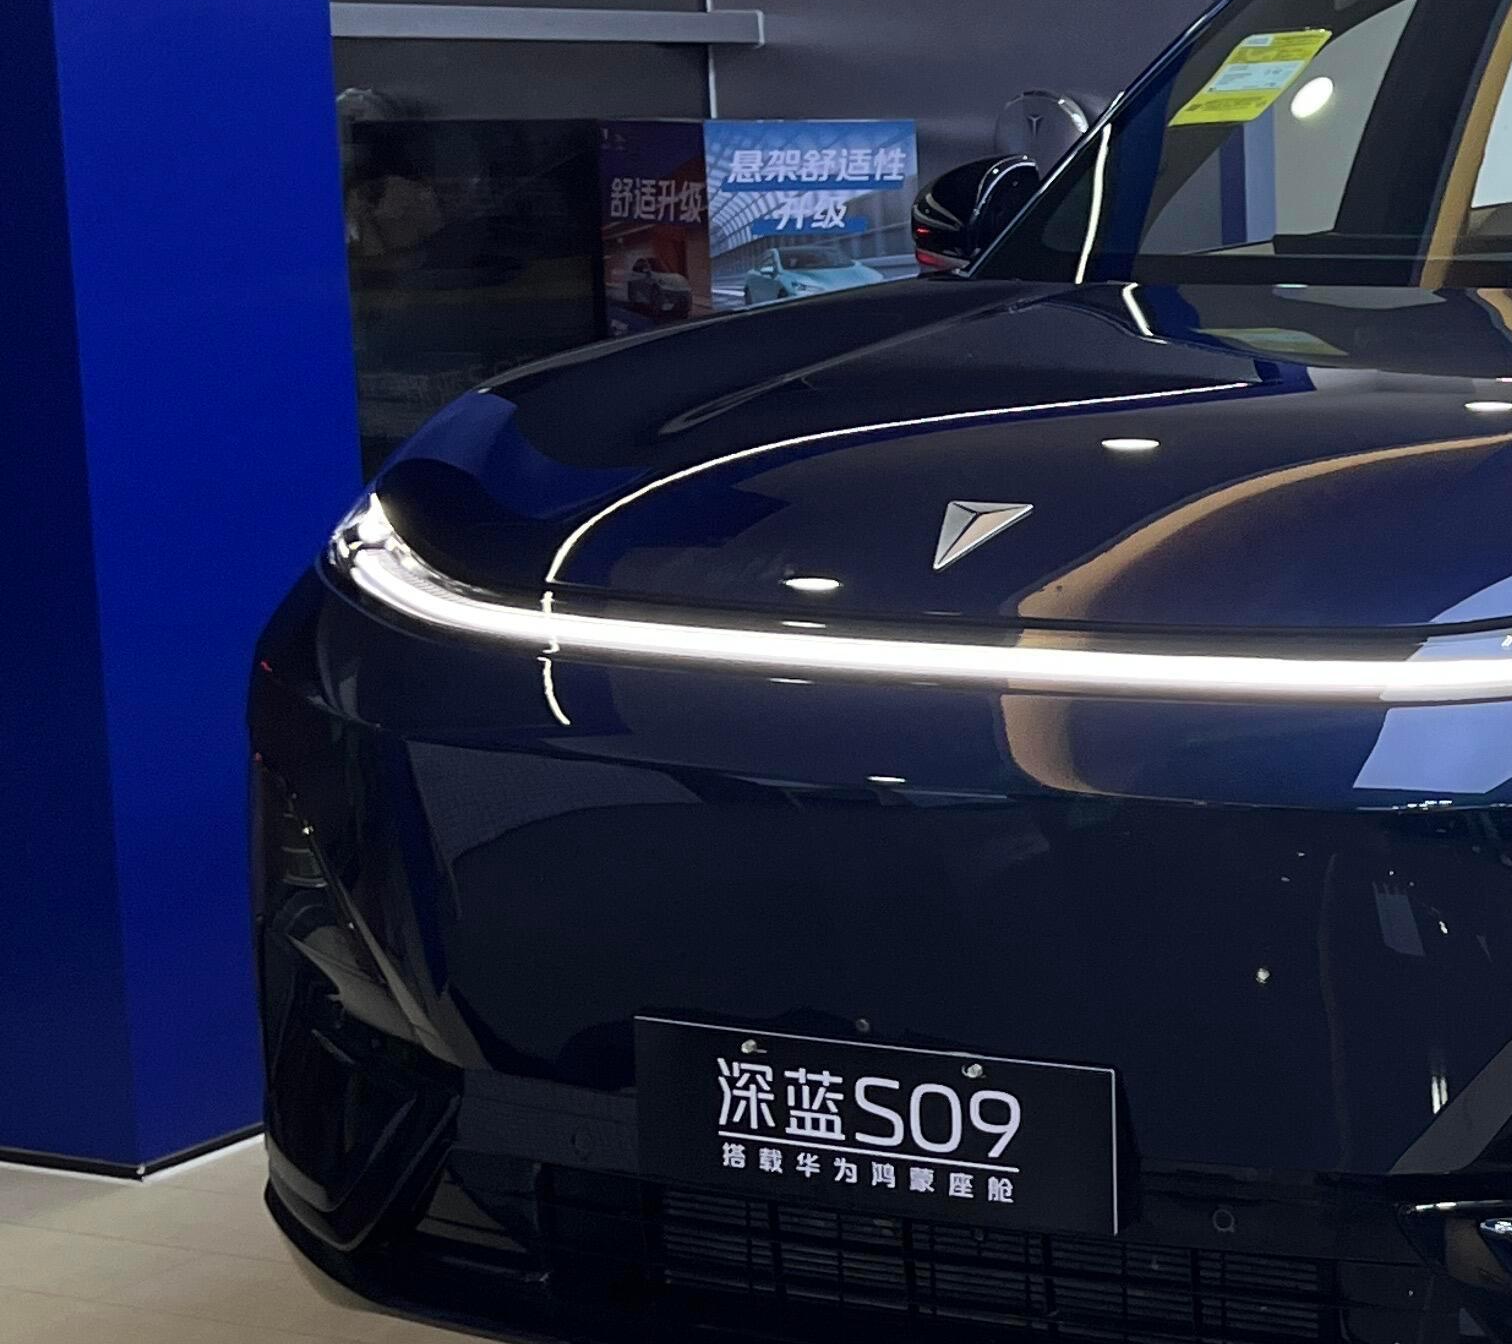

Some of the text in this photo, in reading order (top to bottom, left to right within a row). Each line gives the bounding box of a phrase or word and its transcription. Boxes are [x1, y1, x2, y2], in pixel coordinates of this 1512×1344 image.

[728, 147, 906, 184] 悬架舒适性
[610, 177, 704, 223] 舒适升级
[769, 195, 847, 230] 升级
[716, 1057, 1021, 1159] 深蓝S09
[721, 1142, 1015, 1204] 搭载华为鸿蒙座舱
